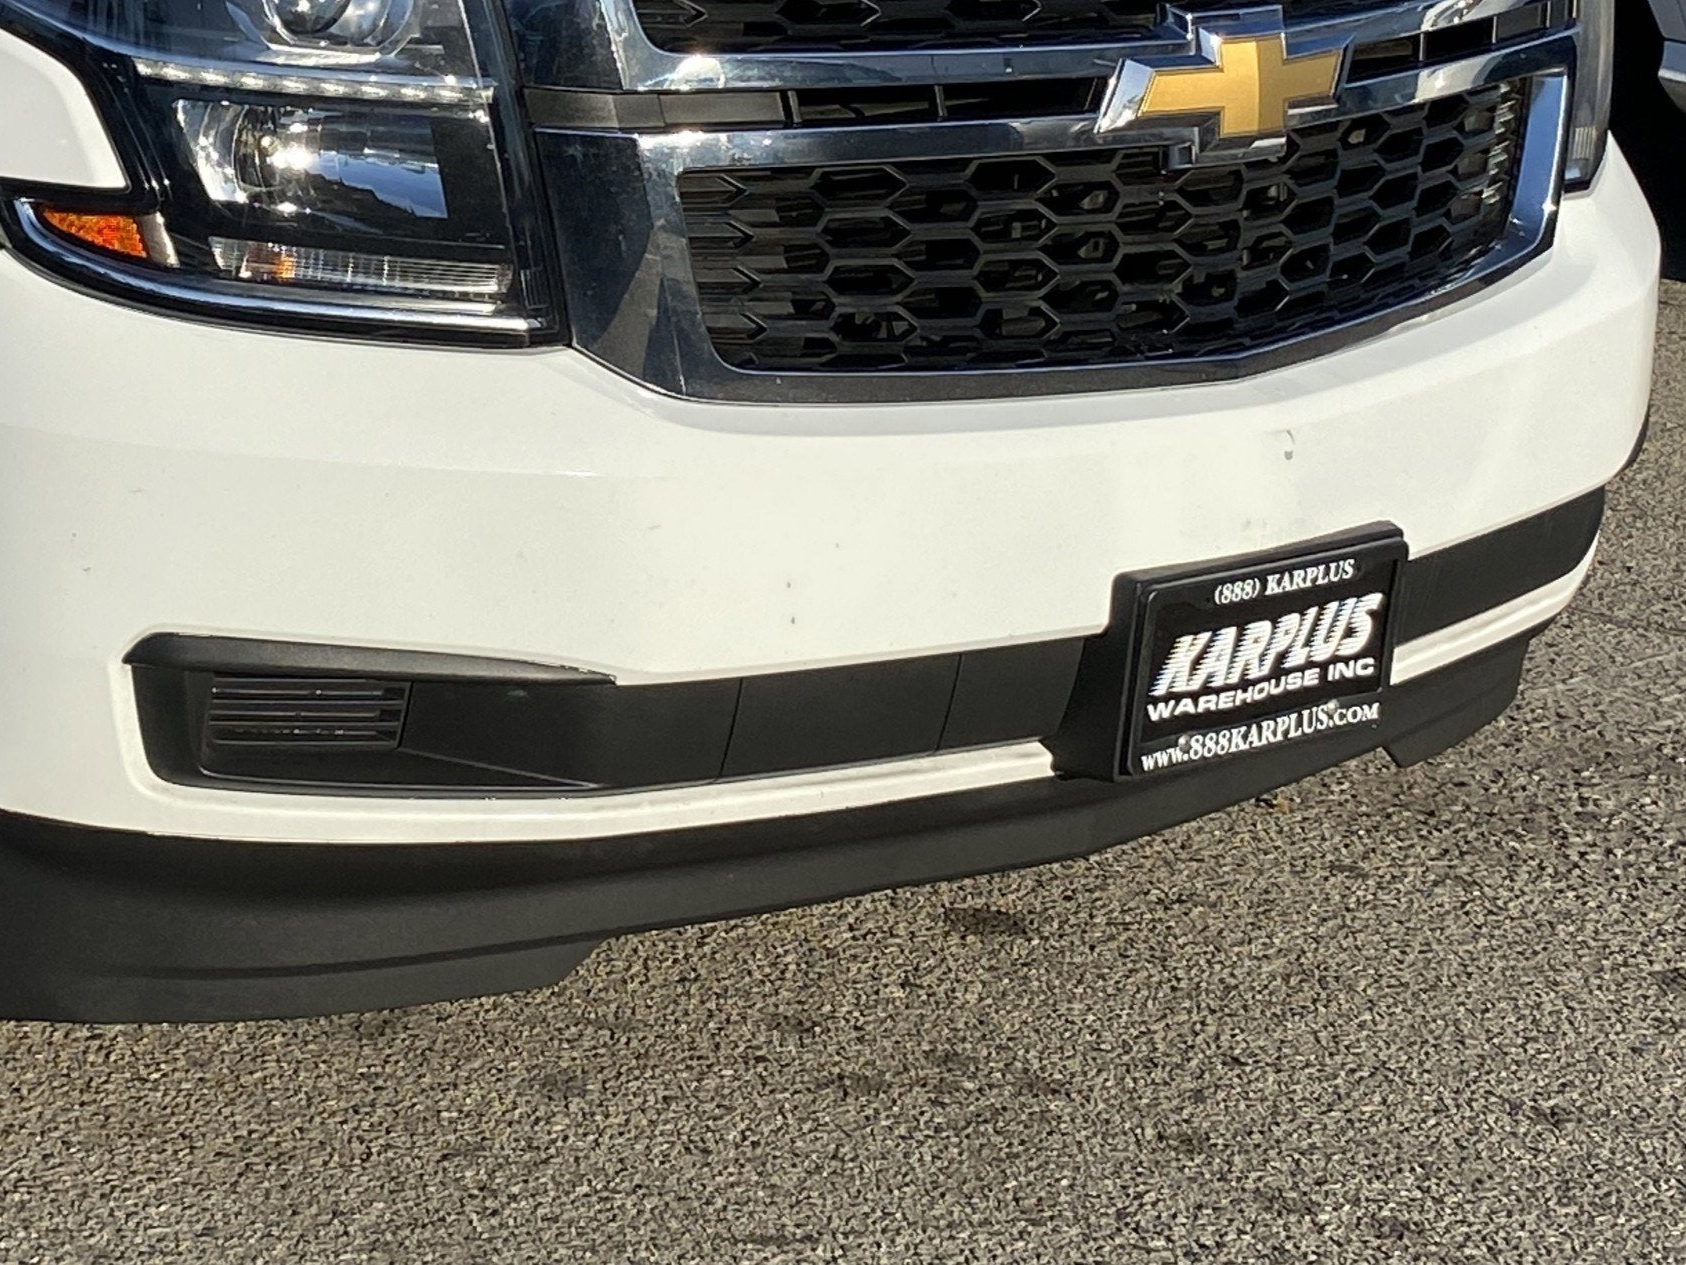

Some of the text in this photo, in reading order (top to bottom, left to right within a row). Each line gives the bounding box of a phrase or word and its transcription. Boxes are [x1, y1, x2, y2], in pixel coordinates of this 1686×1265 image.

[1214, 559, 1355, 605] (888) KARPLUS
[1148, 592, 1384, 696] KARPLUS
[1146, 657, 1376, 722] WAREHOUSE INC
